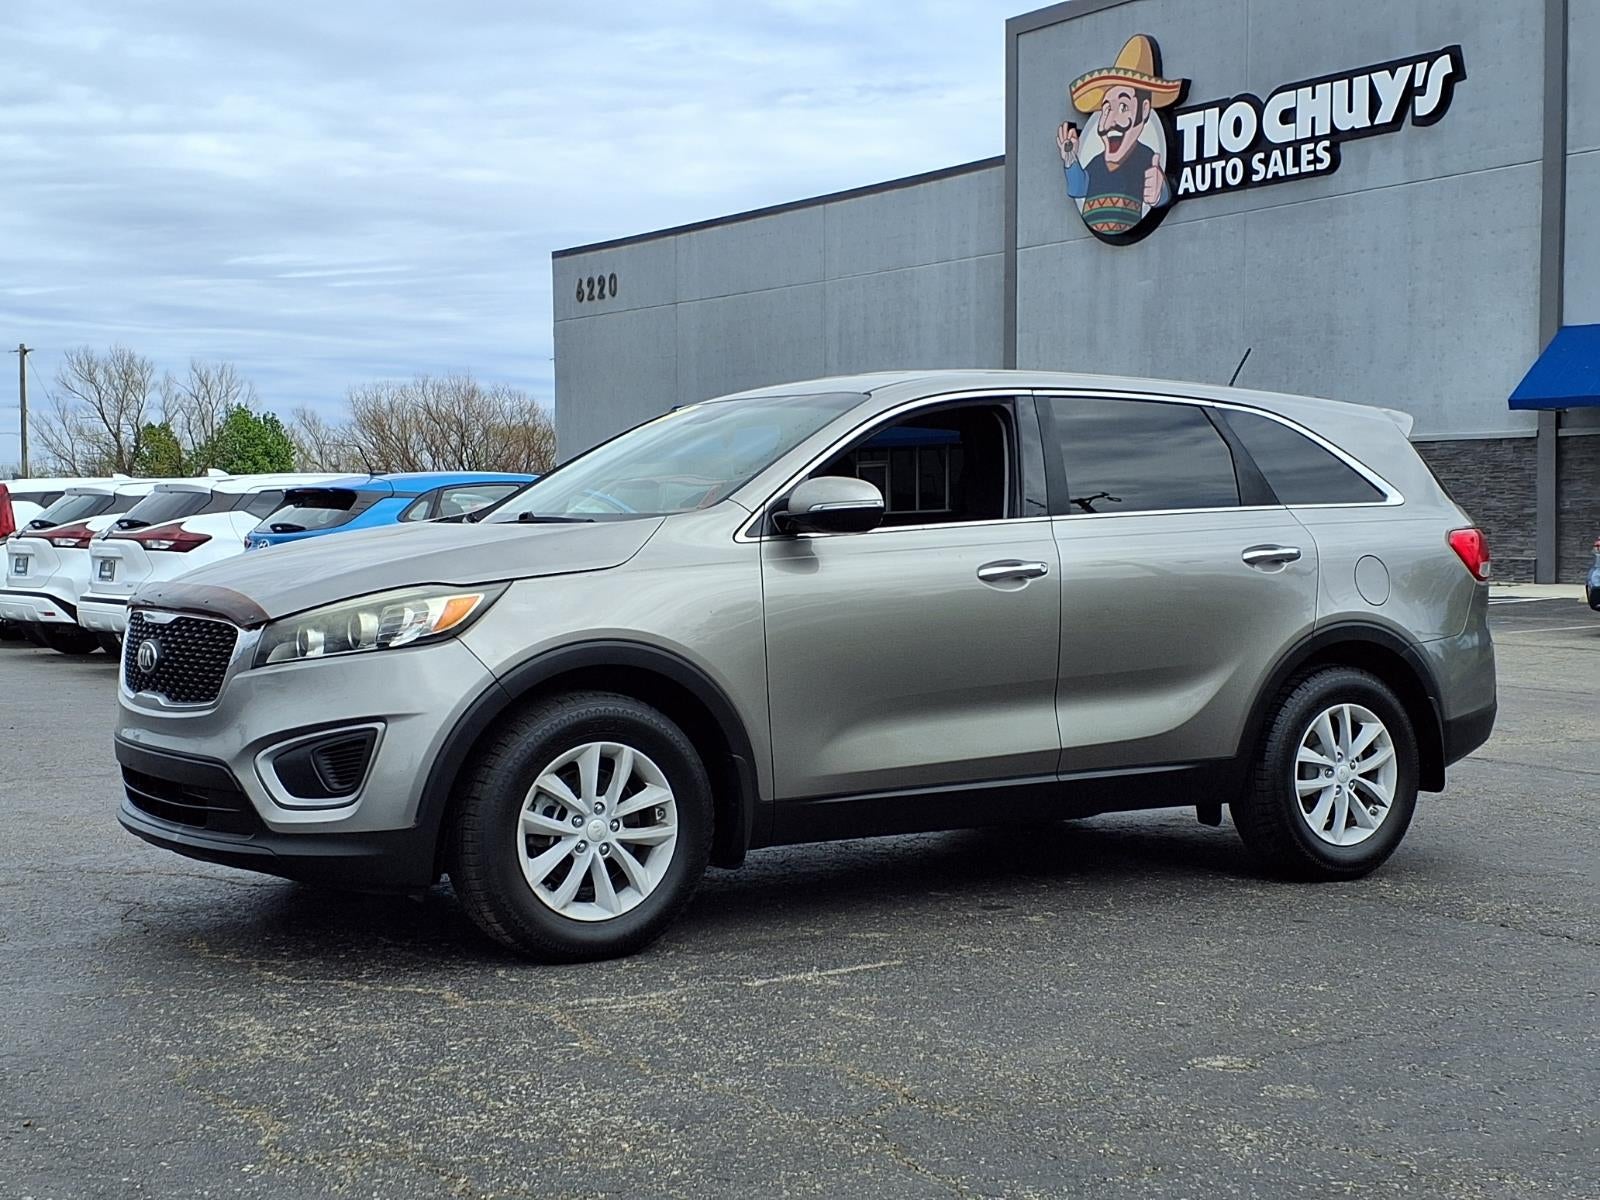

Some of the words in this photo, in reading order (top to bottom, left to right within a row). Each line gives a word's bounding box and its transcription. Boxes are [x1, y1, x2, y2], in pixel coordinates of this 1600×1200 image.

[1176, 101, 1257, 162] TIO
[1259, 54, 1453, 144] CHUY'S
[1177, 157, 1244, 195] AUTO
[1251, 140, 1331, 182] SALES
[575, 272, 618, 303] 6220
